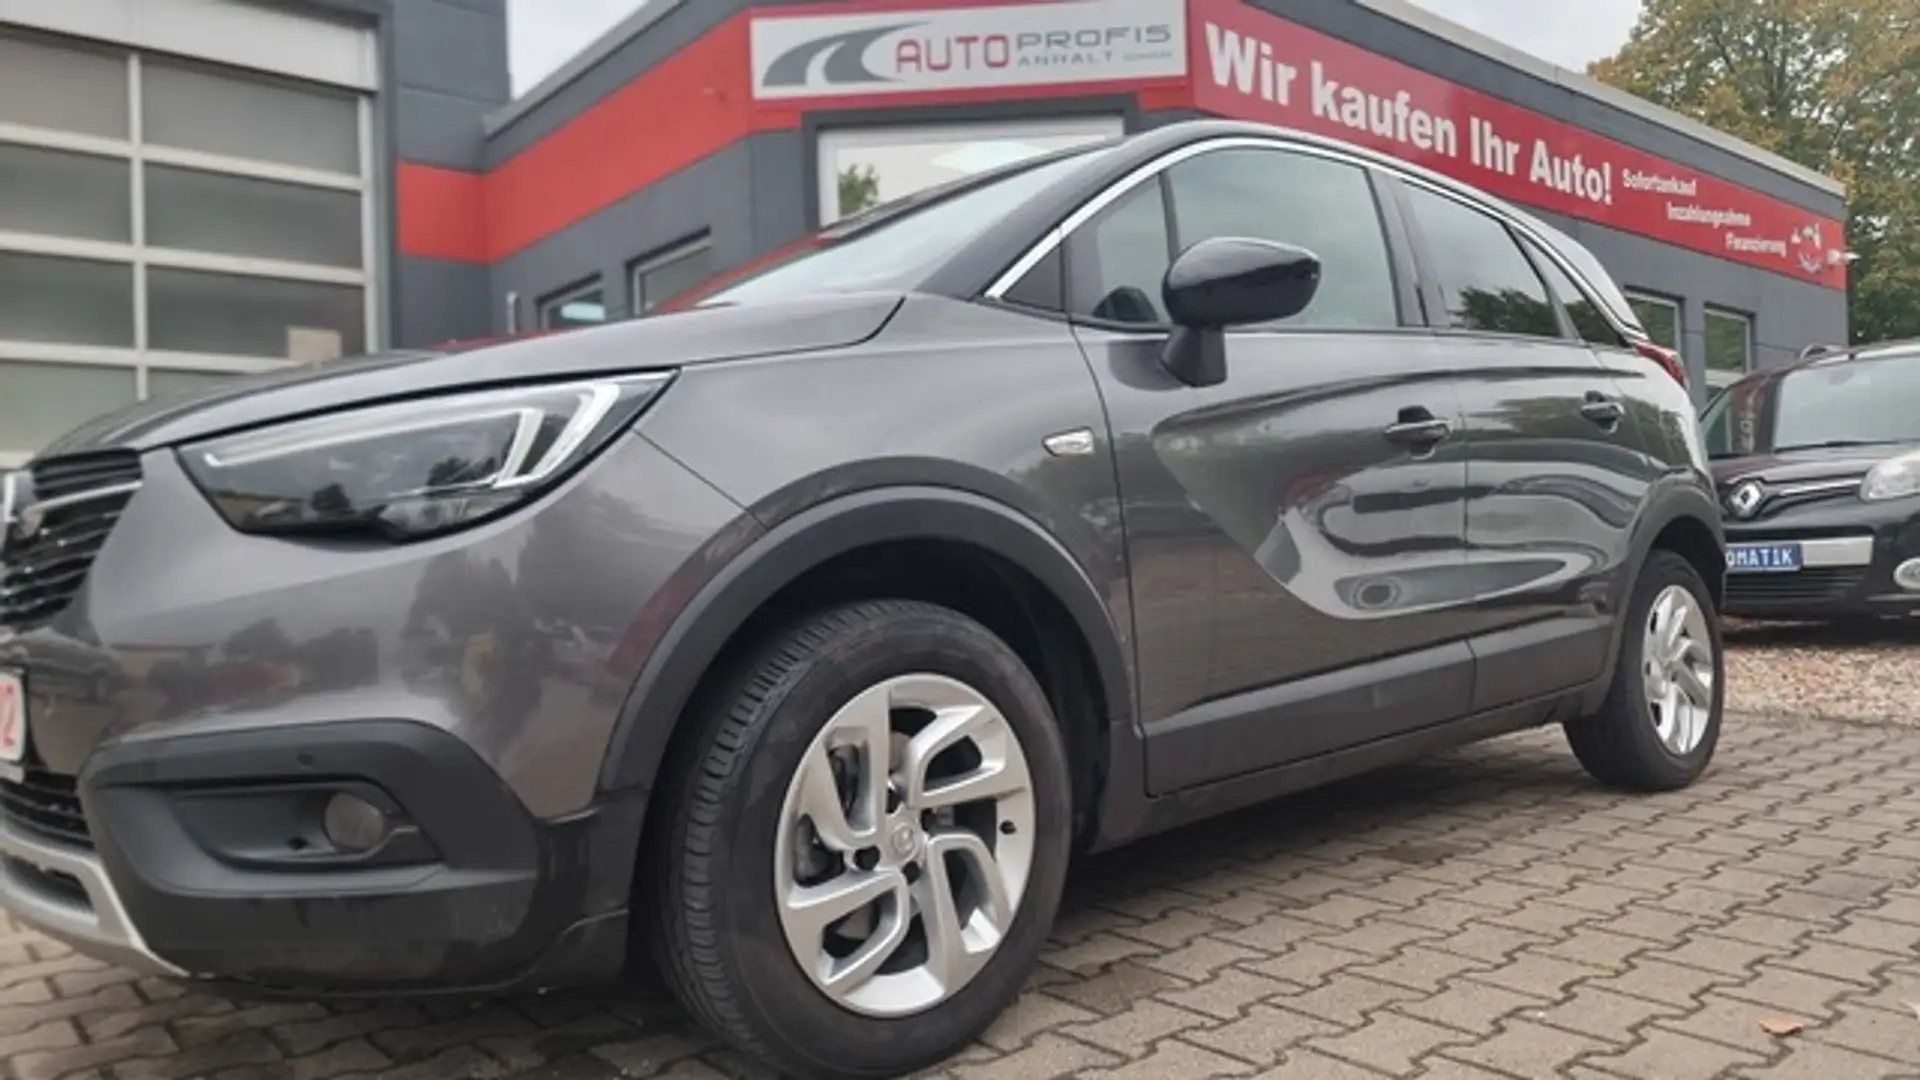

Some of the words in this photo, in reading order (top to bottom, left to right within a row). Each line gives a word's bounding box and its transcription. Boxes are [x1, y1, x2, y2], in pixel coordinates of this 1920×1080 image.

[1016, 51, 1113, 67] ANHALT
[1204, 21, 1297, 106] Wir
[1310, 59, 1458, 158] kaufen
[1470, 115, 1520, 175] Ihr
[1529, 137, 1612, 205] Auto!
